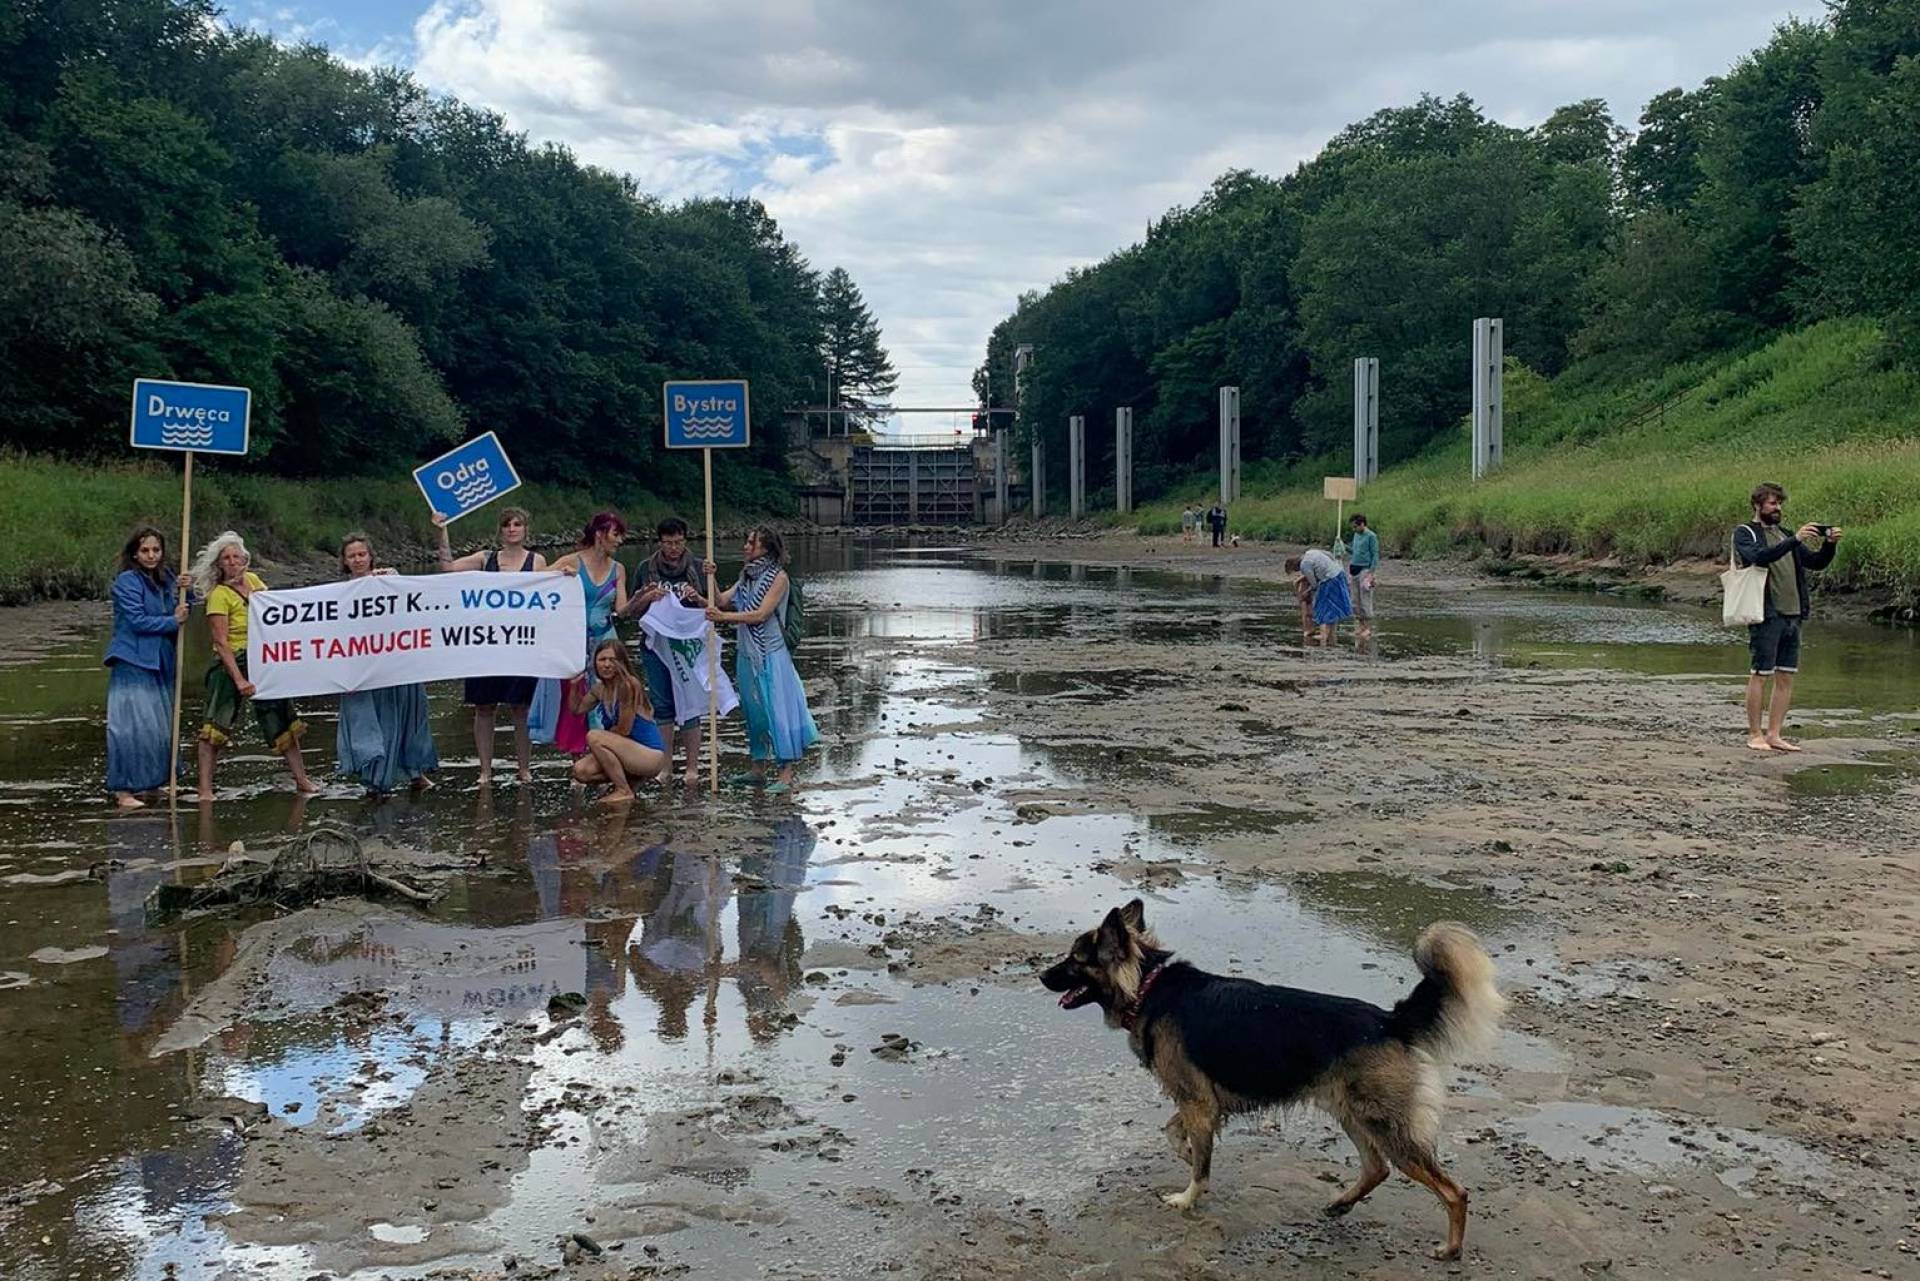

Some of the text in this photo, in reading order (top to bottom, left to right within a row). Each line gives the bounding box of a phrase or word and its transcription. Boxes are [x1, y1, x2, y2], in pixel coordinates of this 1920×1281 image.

[148, 395, 230, 425] Drwęca
[674, 395, 737, 417] Bystra
[437, 457, 489, 490] Odra
[261, 589, 561, 626] GDZIE JEST K... WODA?
[262, 625, 536, 664] NIE TAMUJCIE WISŁY!!!
